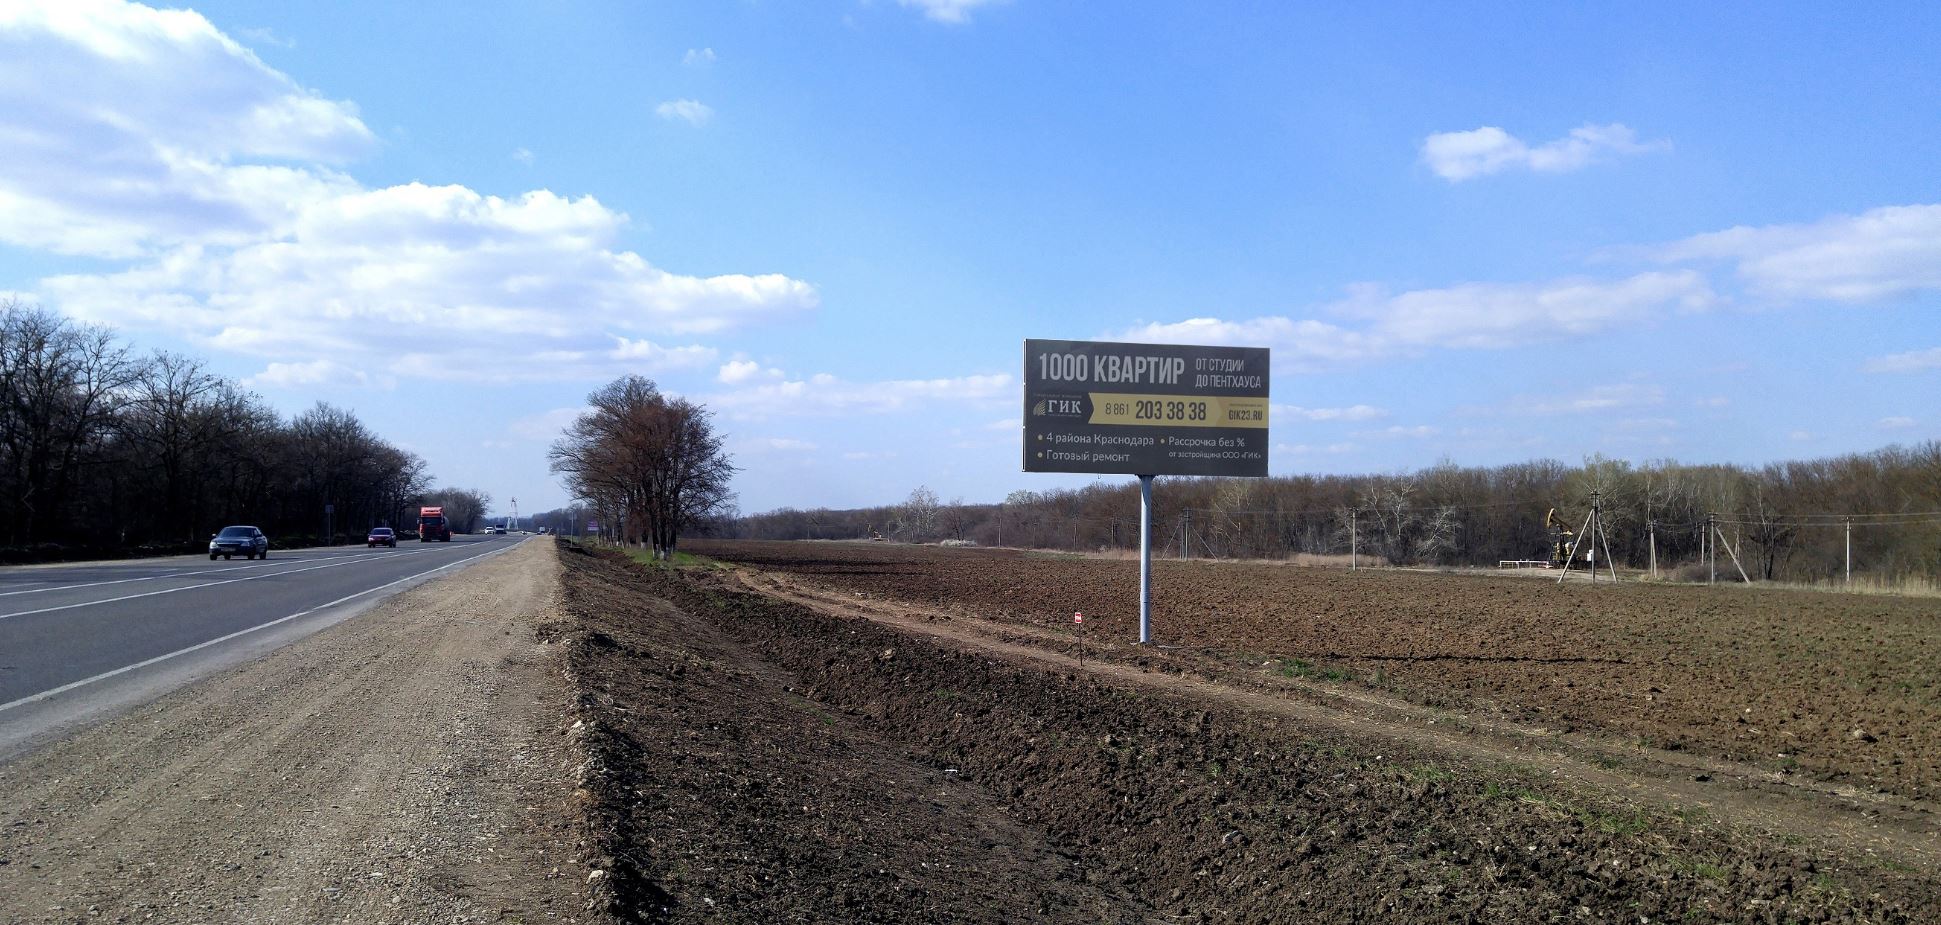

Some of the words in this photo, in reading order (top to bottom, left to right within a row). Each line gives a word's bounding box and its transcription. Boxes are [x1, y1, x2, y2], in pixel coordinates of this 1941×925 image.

[1039, 352, 1088, 381] 1000
[1094, 355, 1185, 384] КВАРТИР
[1195, 358, 1207, 371] ОТ
[1209, 358, 1244, 373] СТУДИИ
[1195, 374, 1208, 388] ДО
[1210, 375, 1262, 388] ПЕНТХАУСА
[1048, 399, 1082, 414] ГИК
[1105, 402, 1111, 415] 8
[1113, 403, 1129, 416] 861
[1135, 400, 1162, 420] 203
[1166, 401, 1185, 420] 38
[1188, 402, 1207, 421] 38
[1228, 409, 1263, 421] GIK23.RU
[1046, 432, 1054, 442] 4
[1055, 433, 1092, 444] района
[1094, 434, 1154, 446] Краснодара
[1168, 436, 1216, 447] Рассрочка
[1218, 437, 1234, 446] без
[1236, 437, 1245, 447] %
[1046, 449, 1090, 460] Готовый
[1092, 453, 1130, 462] ремонт
[1222, 451, 1240, 459] ООО
